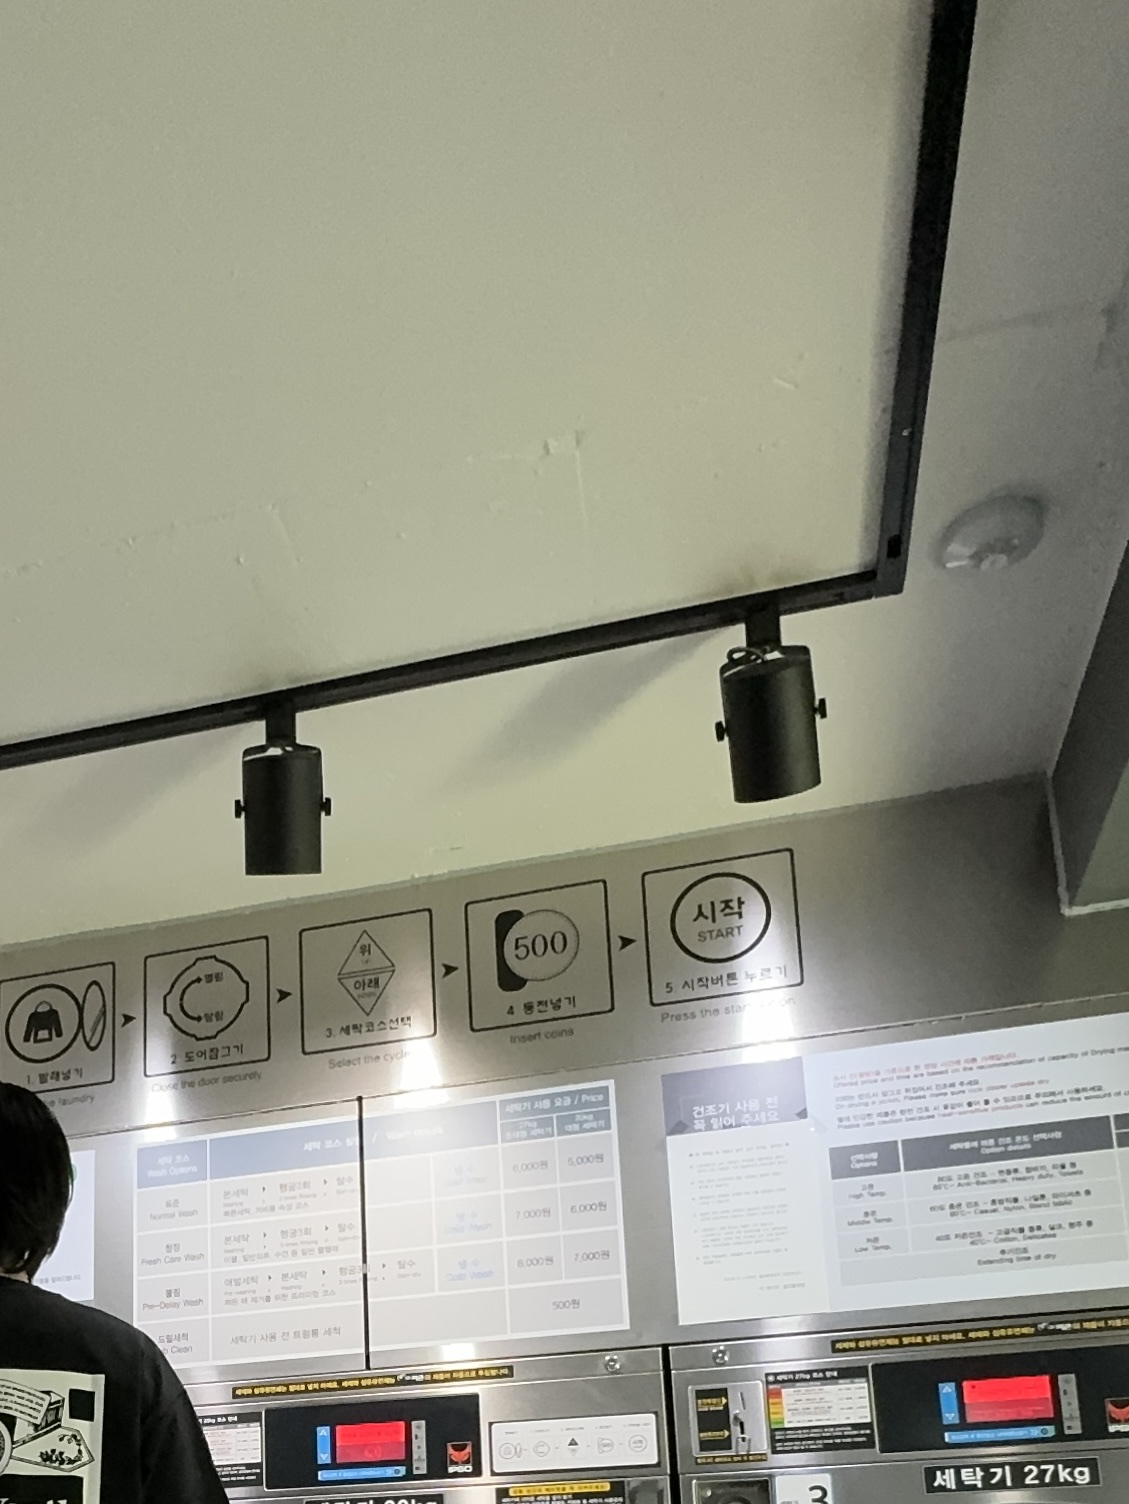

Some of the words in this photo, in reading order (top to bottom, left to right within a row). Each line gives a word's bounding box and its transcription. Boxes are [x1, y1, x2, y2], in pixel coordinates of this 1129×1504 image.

[692, 896, 746, 924] 시작
[697, 925, 744, 943] START
[514, 930, 568, 961] 500
[353, 976, 380, 991] 아래
[682, 971, 739, 991] 시작버튼
[661, 1010, 698, 1023] Press
[328, 1056, 361, 1070] Select
[364, 1054, 381, 1065] the
[198, 1076, 220, 1088] door
[693, 1102, 730, 1118] 건조기
[933, 1465, 1012, 1489] 세탁기
[1023, 1463, 1091, 1485] 27kg
